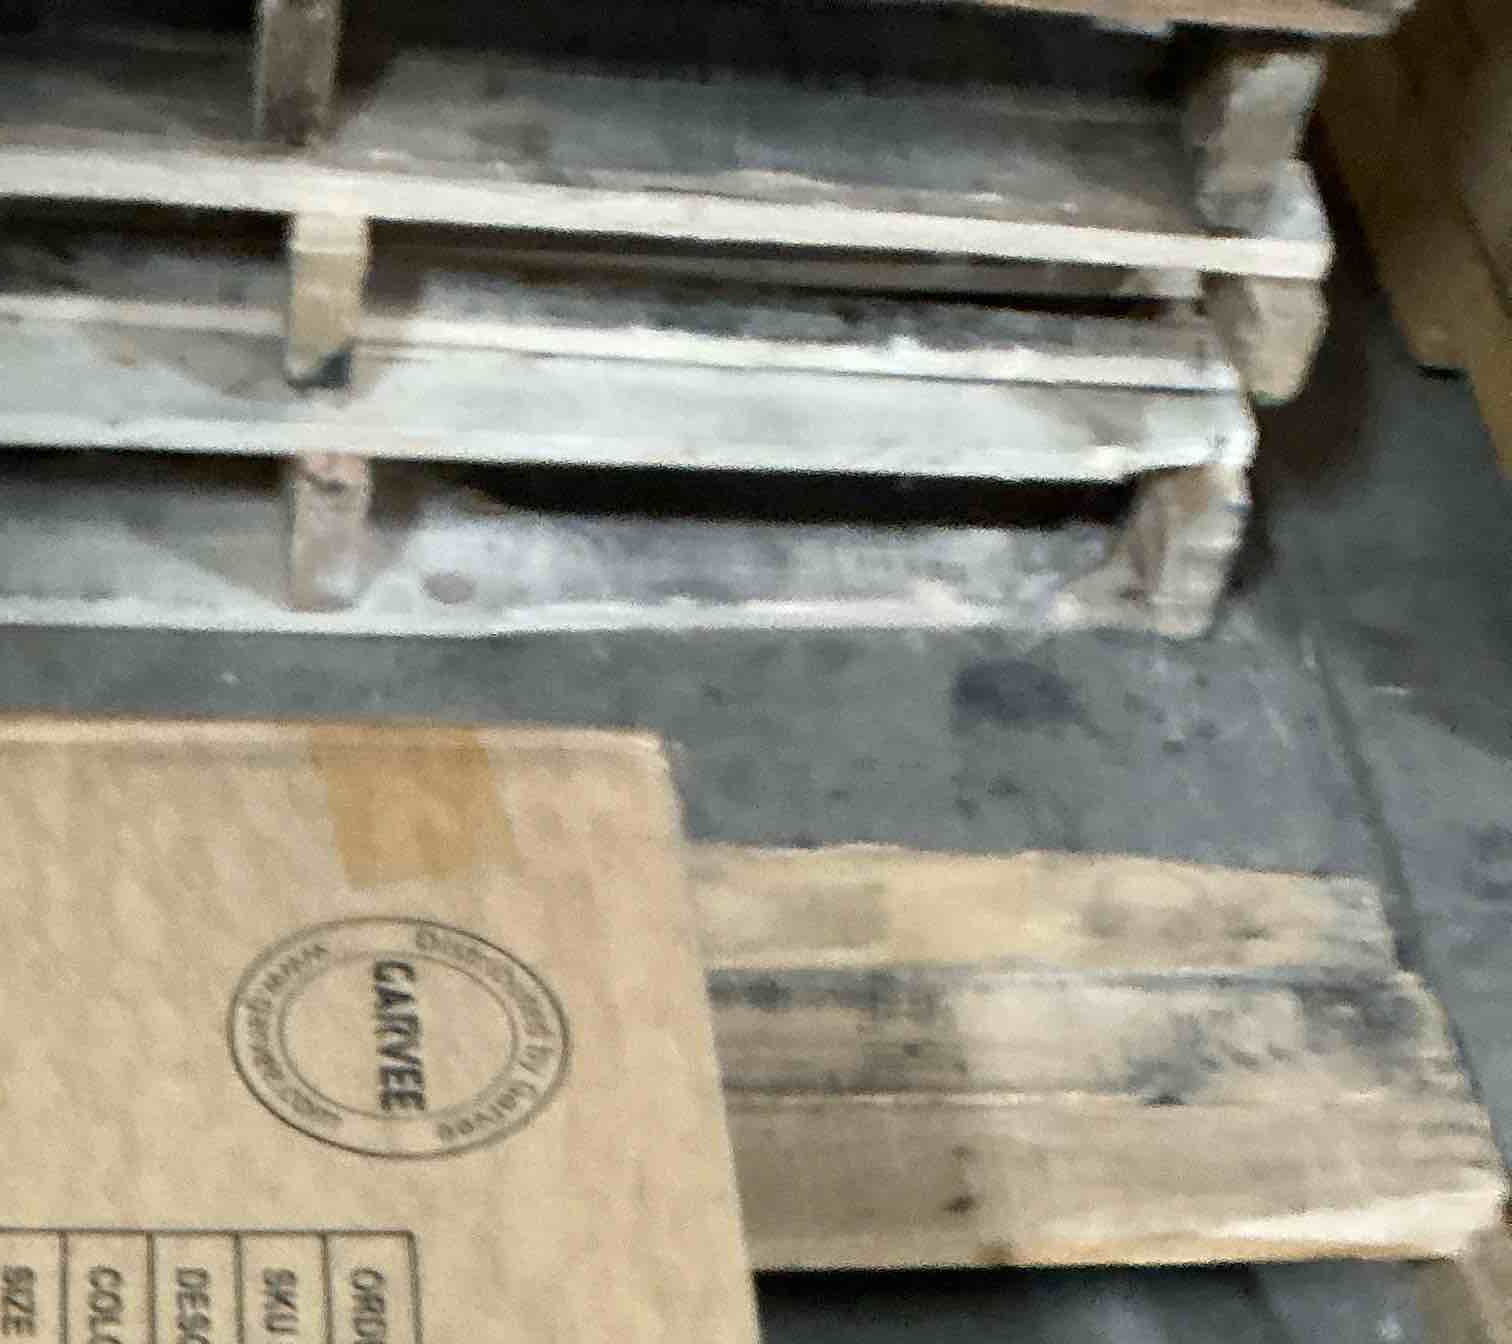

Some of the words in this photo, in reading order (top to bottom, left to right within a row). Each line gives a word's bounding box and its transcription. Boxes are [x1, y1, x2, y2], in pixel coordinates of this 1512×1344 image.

[375, 960, 425, 1111] GARVEE
[0, 1266, 33, 1337] SIZE
[262, 1269, 298, 1333] SKU
